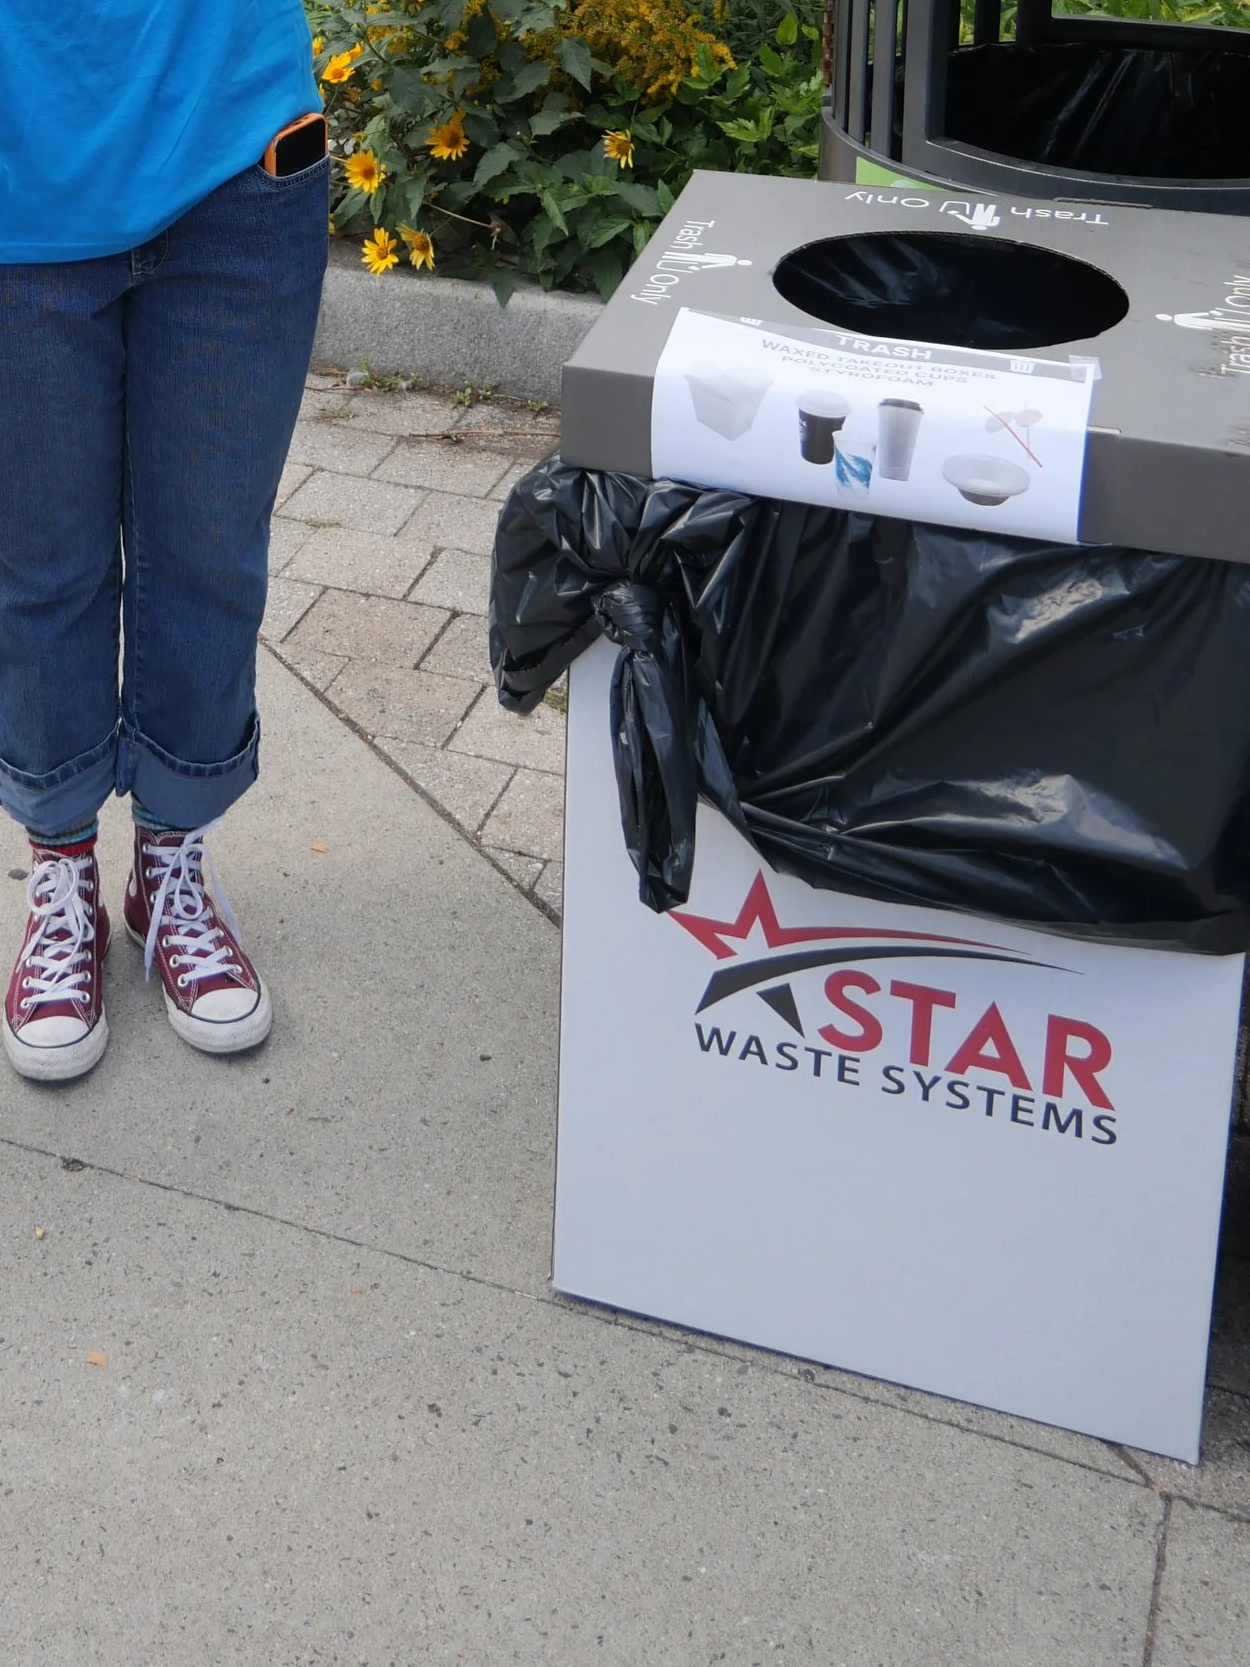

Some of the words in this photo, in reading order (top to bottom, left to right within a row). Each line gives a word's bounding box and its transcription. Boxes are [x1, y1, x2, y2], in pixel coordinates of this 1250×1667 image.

[845, 190, 930, 208] Only
[1011, 206, 1110, 226] Trash
[670, 220, 716, 249] Trash
[630, 273, 680, 305] Only
[761, 338, 830, 360] WAXED
[837, 356, 924, 370] TAKEOUT
[931, 367, 996, 380] BOXES
[833, 334, 932, 360] TRASH
[781, 355, 908, 375] POLYCOATED
[914, 371, 968, 383] CUPS
[809, 366, 933, 387] STYROFOAM
[817, 968, 1116, 1111] STAR
[694, 1022, 860, 1086] WASTE
[881, 1064, 1118, 1145] SYSTEMS
